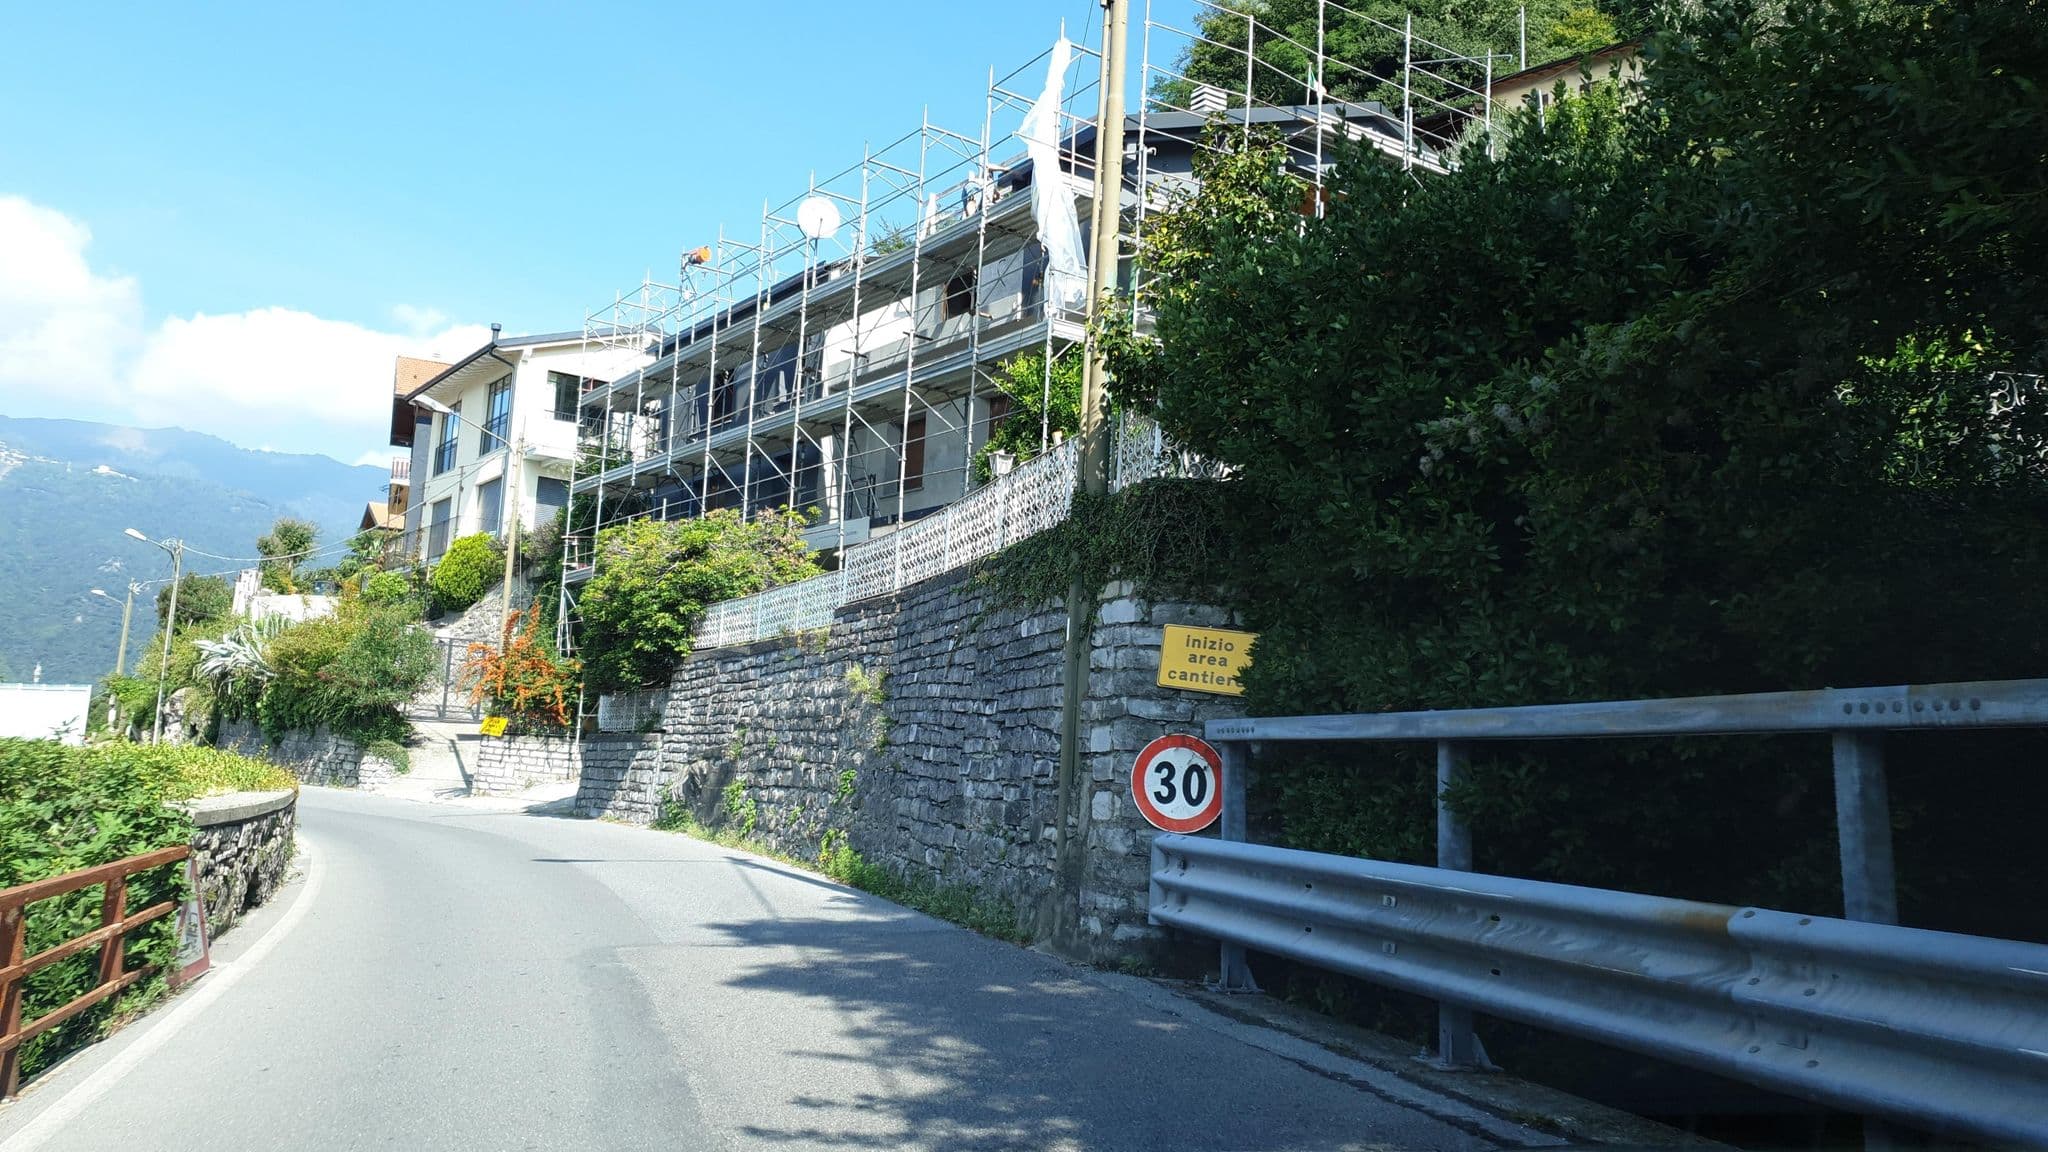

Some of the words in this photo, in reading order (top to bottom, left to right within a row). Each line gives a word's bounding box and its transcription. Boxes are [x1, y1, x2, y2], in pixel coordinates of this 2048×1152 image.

[1186, 635, 1234, 652] inizio
[1188, 653, 1228, 667] area
[1153, 761, 1208, 807] 30
